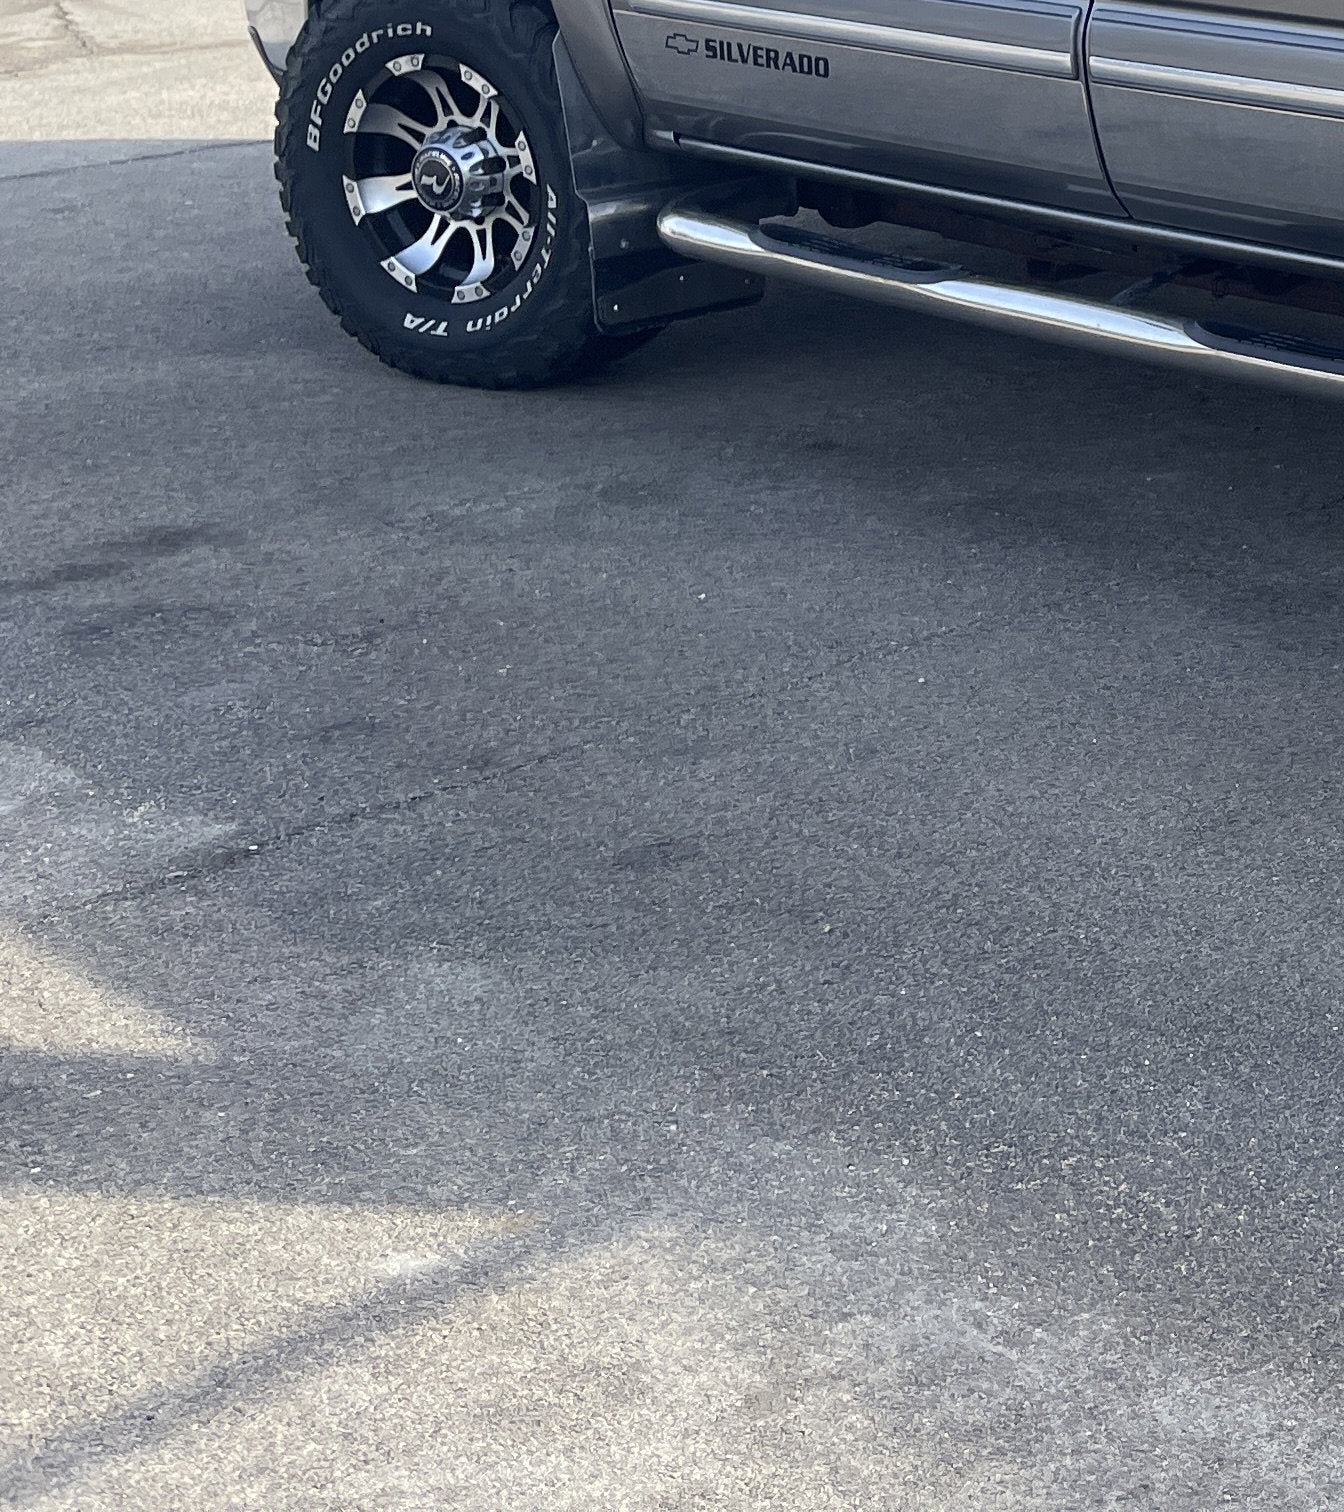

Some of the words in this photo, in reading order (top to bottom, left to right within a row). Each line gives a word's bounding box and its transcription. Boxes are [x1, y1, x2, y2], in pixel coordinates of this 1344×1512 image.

[306, 20, 434, 152] BFGoodrich
[704, 37, 830, 79] SILVERADO
[465, 183, 559, 334] All-Terrain
[402, 311, 450, 337] T/A
